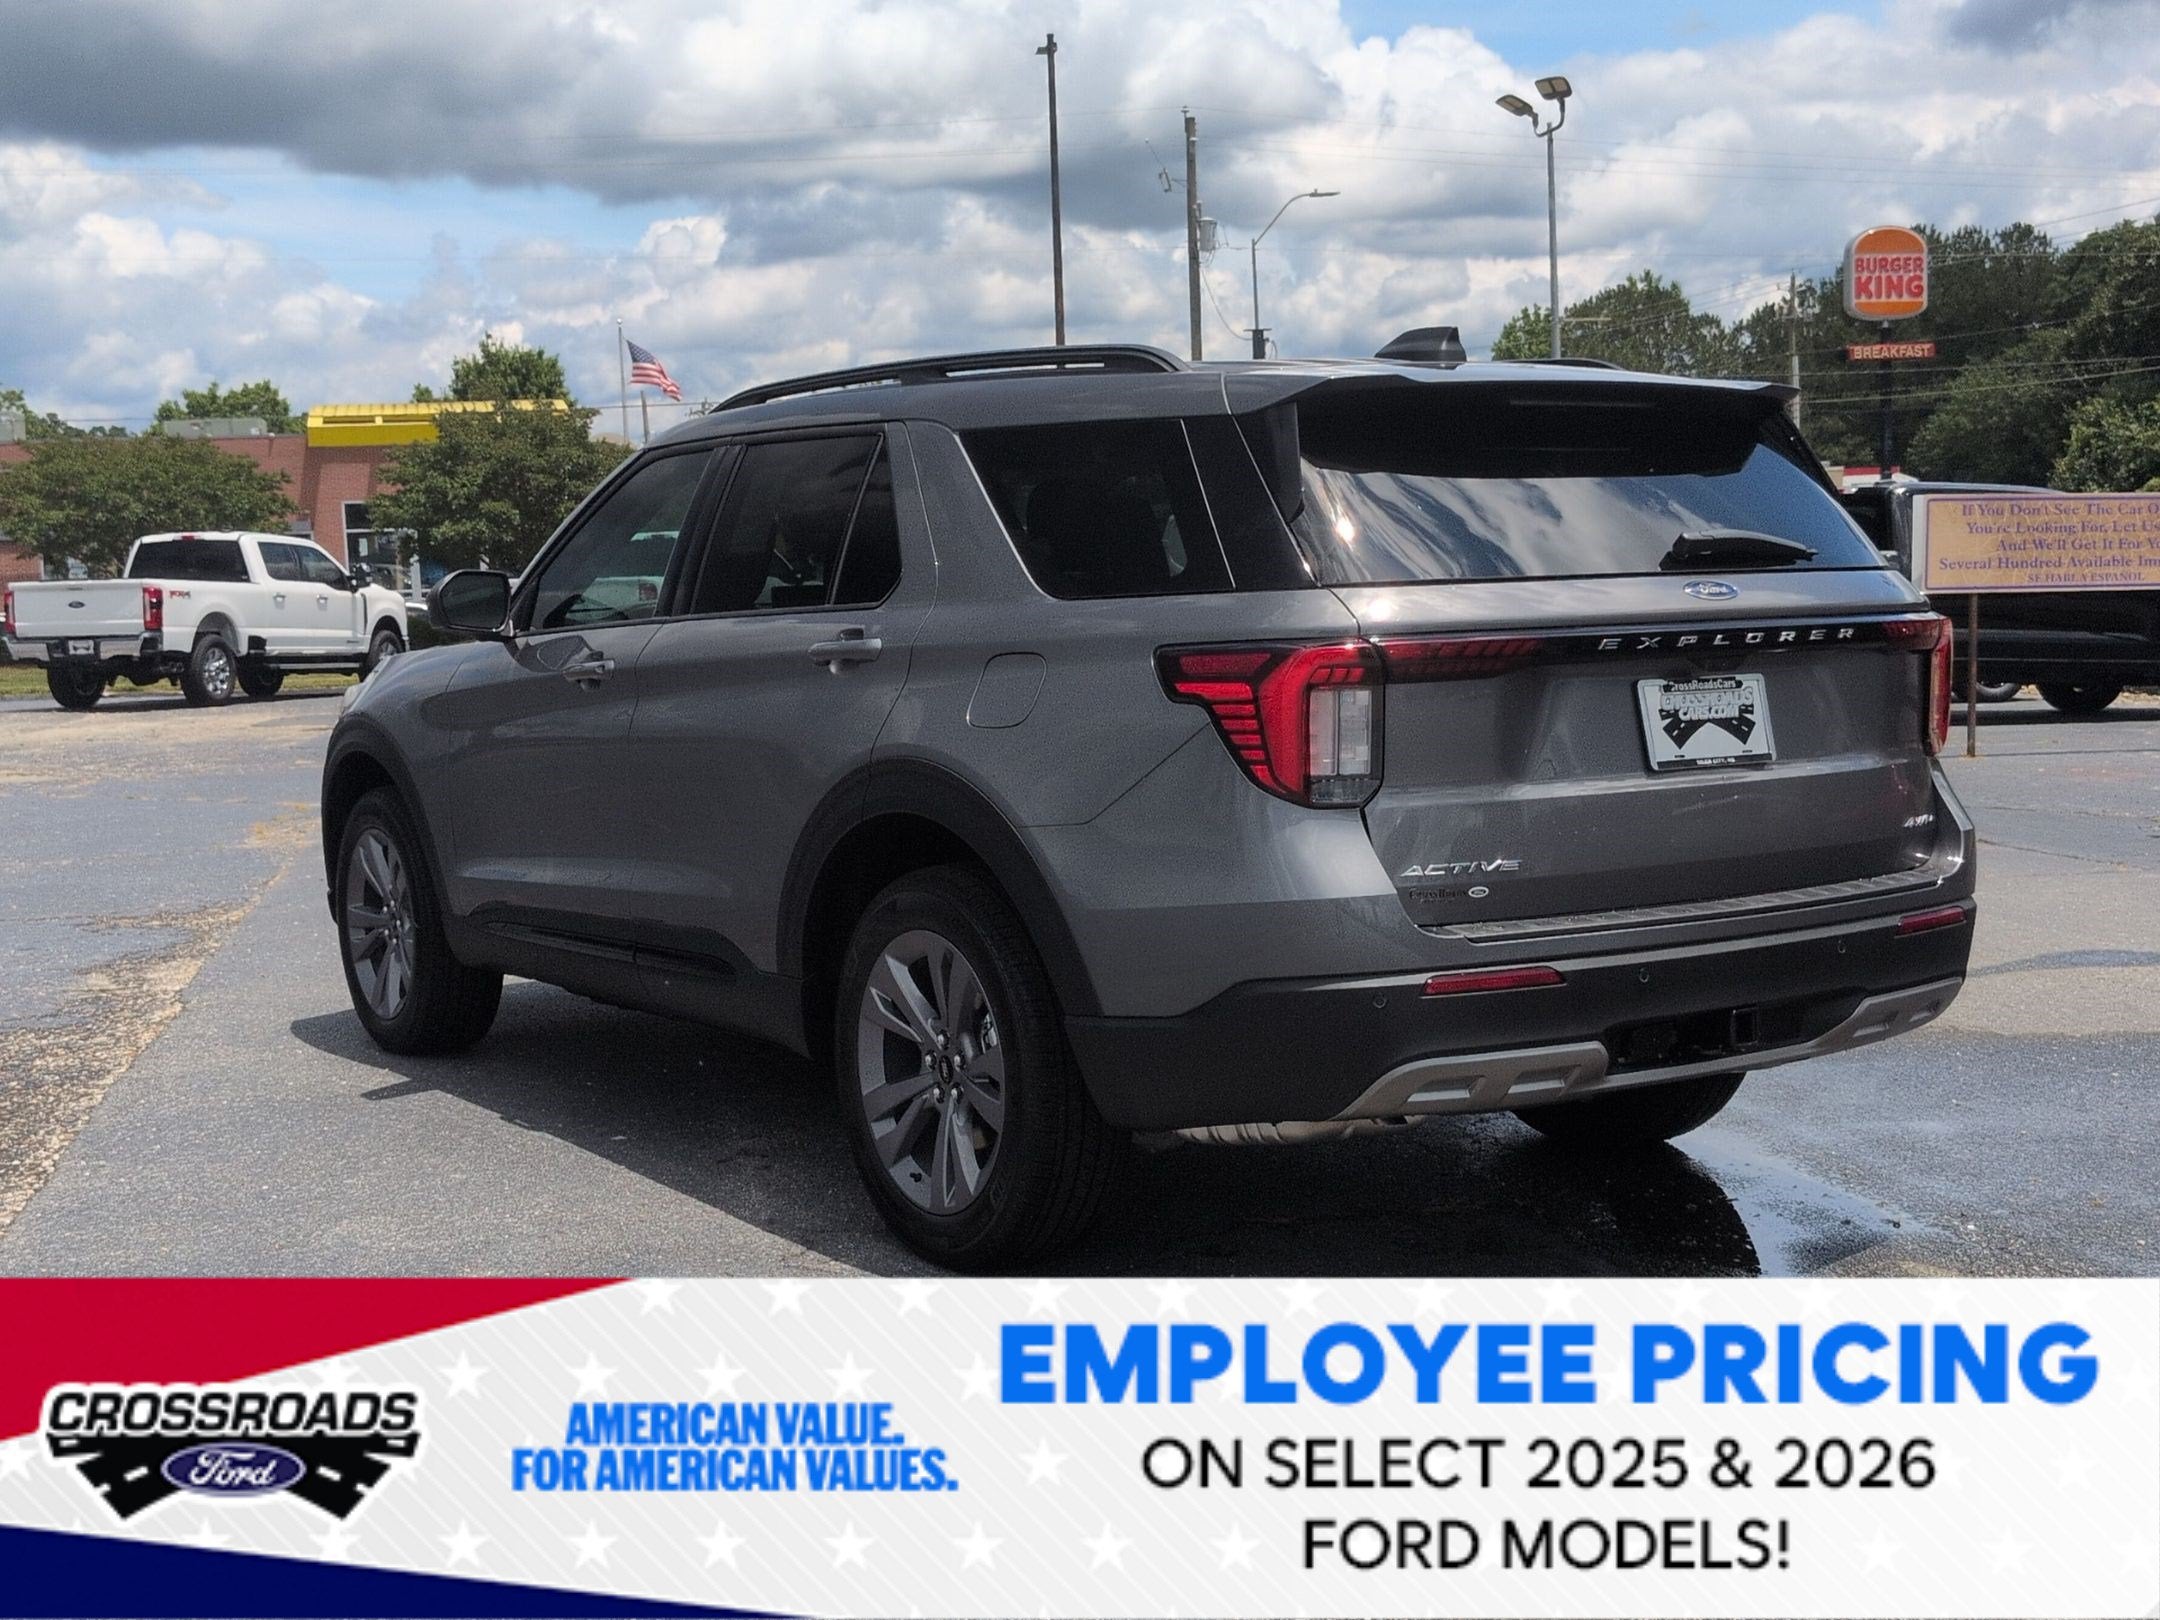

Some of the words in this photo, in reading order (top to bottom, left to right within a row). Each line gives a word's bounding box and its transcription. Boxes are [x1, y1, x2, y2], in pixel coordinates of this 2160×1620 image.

[1854, 256, 1924, 273] BURGER
[1854, 274, 1924, 299] KING
[1854, 343, 1930, 359] BREAKFAST
[1977, 504, 2004, 516] You
[2010, 503, 2049, 516] Don't
[2054, 503, 2080, 515] See
[2087, 503, 2112, 515] The
[2118, 503, 2143, 515] Car
[1967, 522, 2010, 534] You're
[2016, 521, 2076, 534] Looking
[2112, 521, 2136, 532] Let
[1997, 539, 2027, 551] And
[2072, 538, 2097, 550] Get
[2119, 538, 2142, 549] For
[1939, 557, 1991, 569] Several
[1998, 556, 2062, 569] Hundred
[2069, 555, 2132, 567] Available
[1598, 628, 1855, 650] EXPLORER
[1400, 859, 1522, 877] ACTIVE
